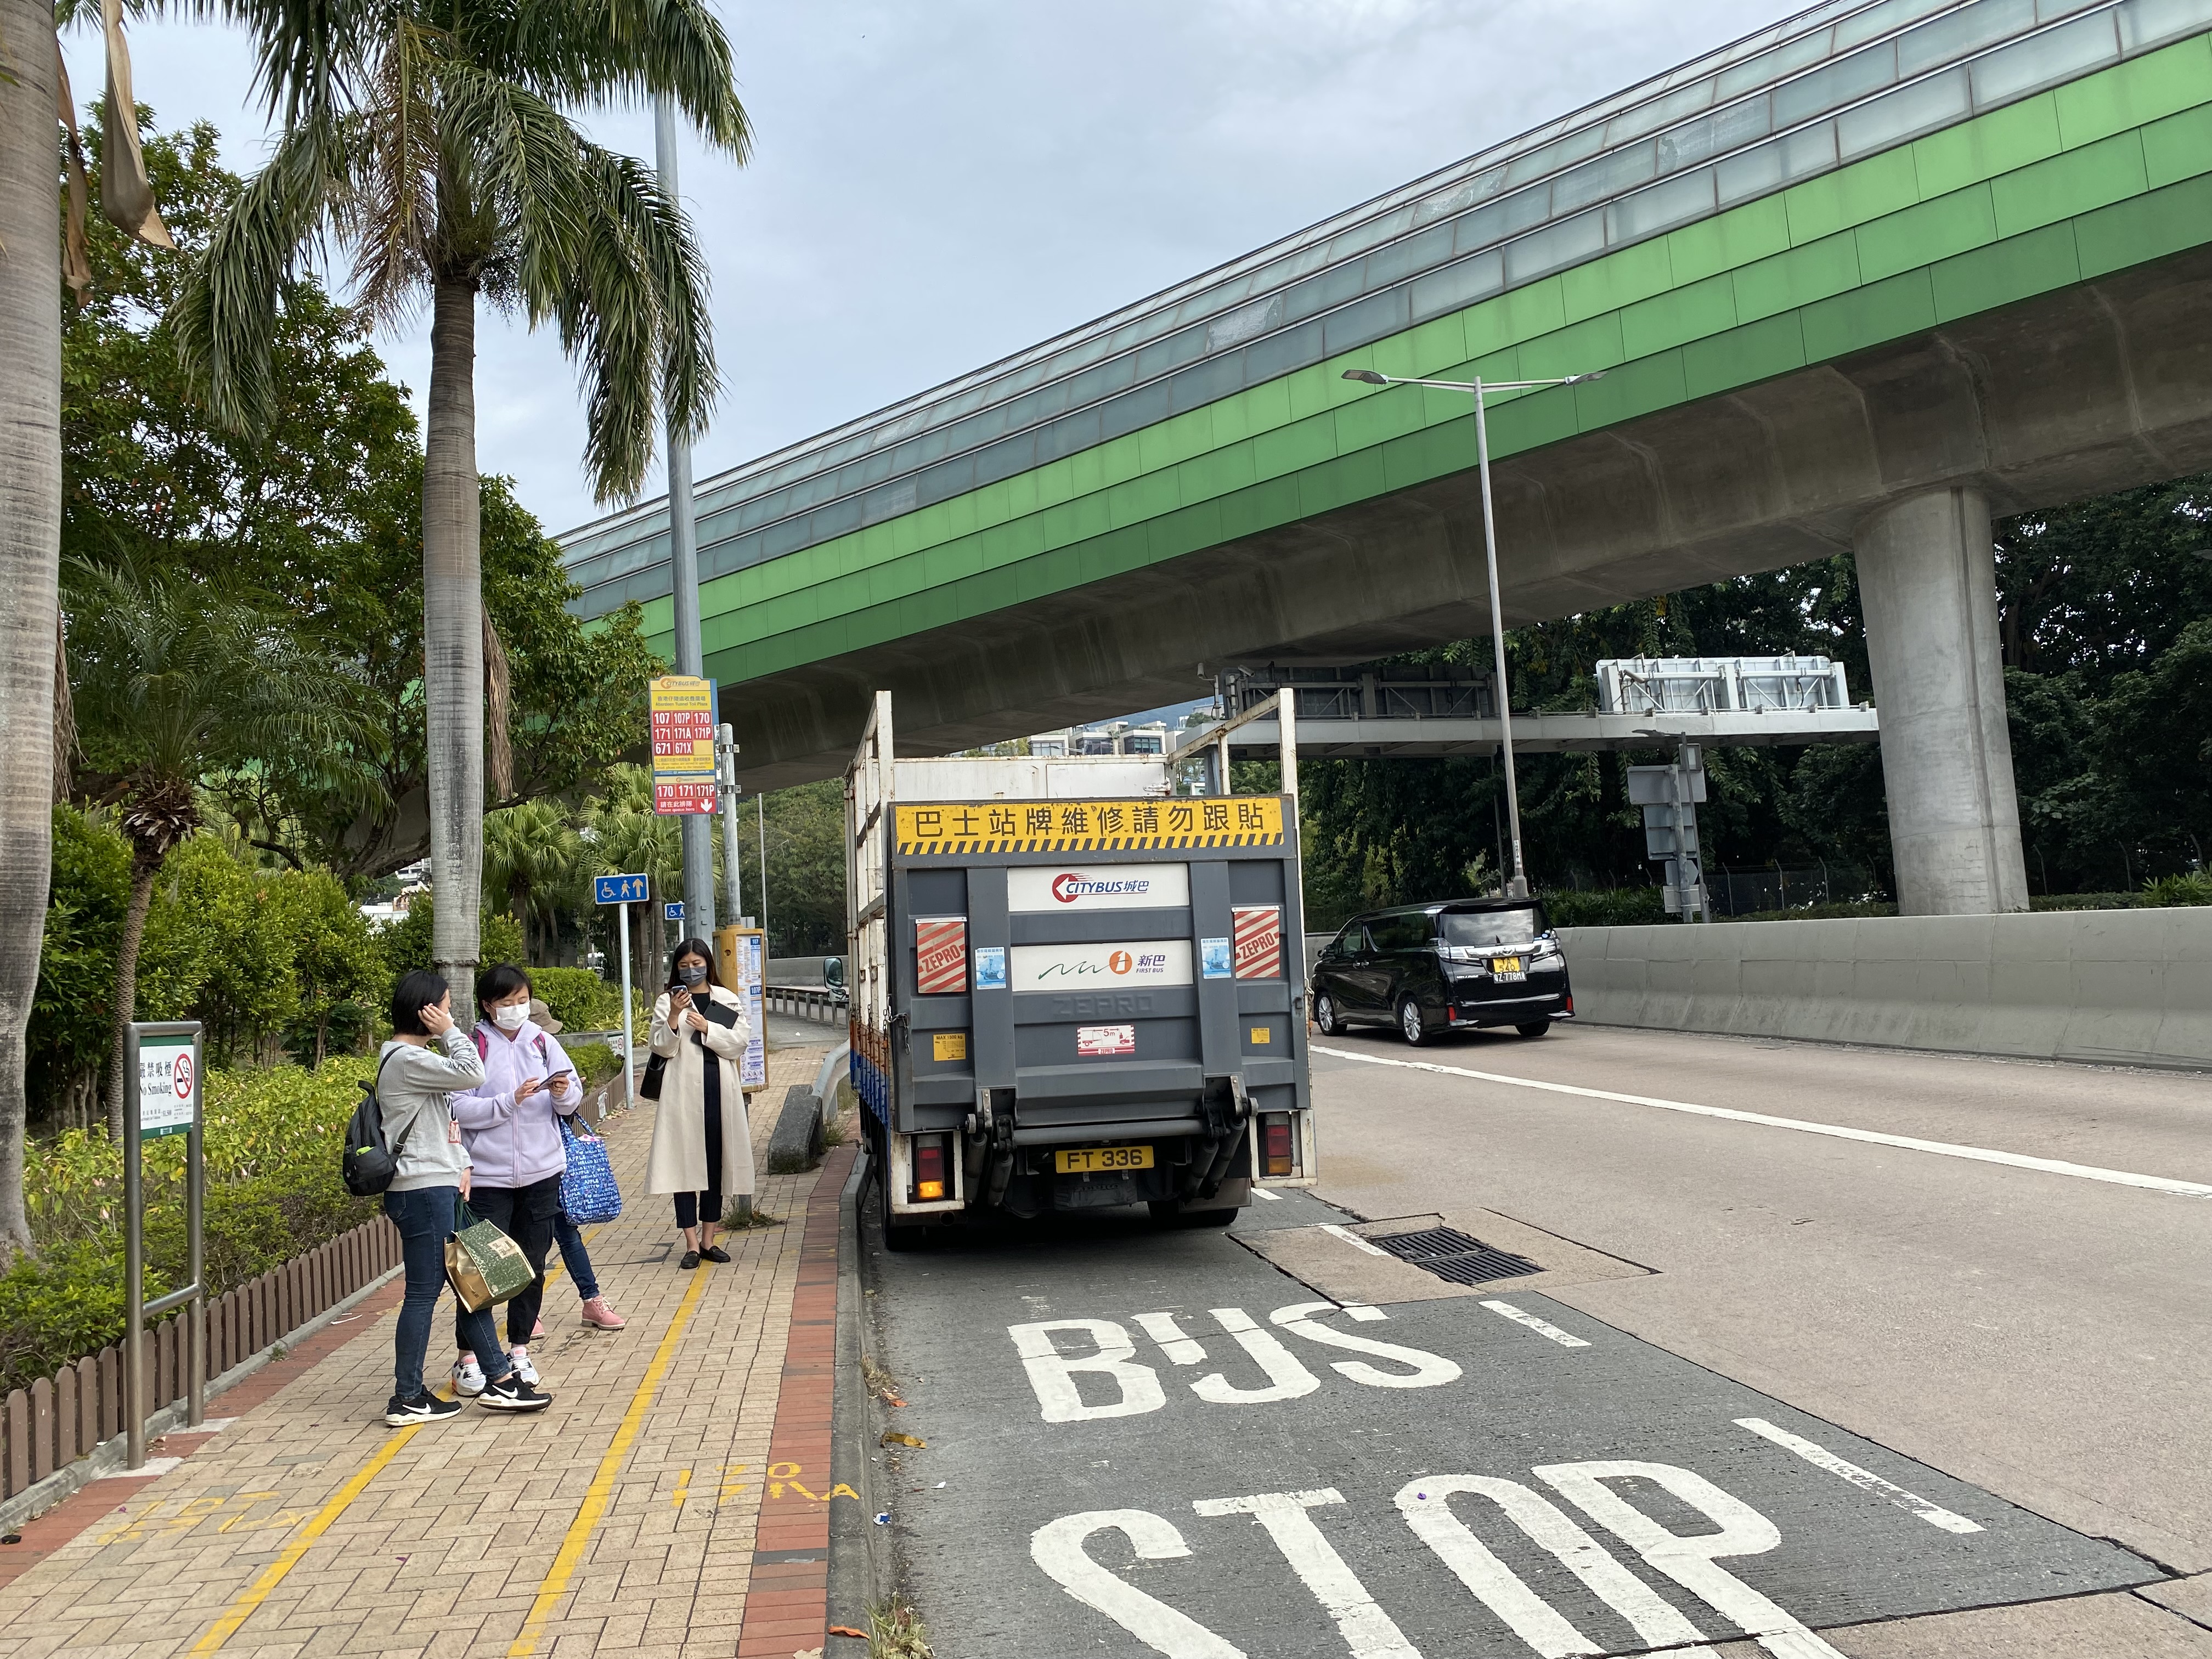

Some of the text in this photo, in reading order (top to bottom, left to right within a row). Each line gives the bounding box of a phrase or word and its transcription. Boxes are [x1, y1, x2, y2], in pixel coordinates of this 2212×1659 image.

[654, 713, 710, 724] 107 107P 170
[654, 727, 711, 740] 171 171A 171P
[656, 742, 692, 754] 671 671X
[658, 785, 714, 797] 170 171 171P
[916, 803, 1263, 838] 巴士站牌維修請勿跟貼
[1066, 880, 1149, 894] CITYBUS 城巴
[1239, 932, 1275, 960] ZEPRO
[922, 944, 961, 973] ZEPRO
[1137, 955, 1165, 967] 新巴
[1052, 995, 1154, 1015] ZEPRO
[148, 1081, 172, 1097] Smoking
[1067, 1149, 1143, 1169] FT 336
[576, 1198, 594, 1206] APPLE
[1007, 1301, 1463, 1423] BUS
